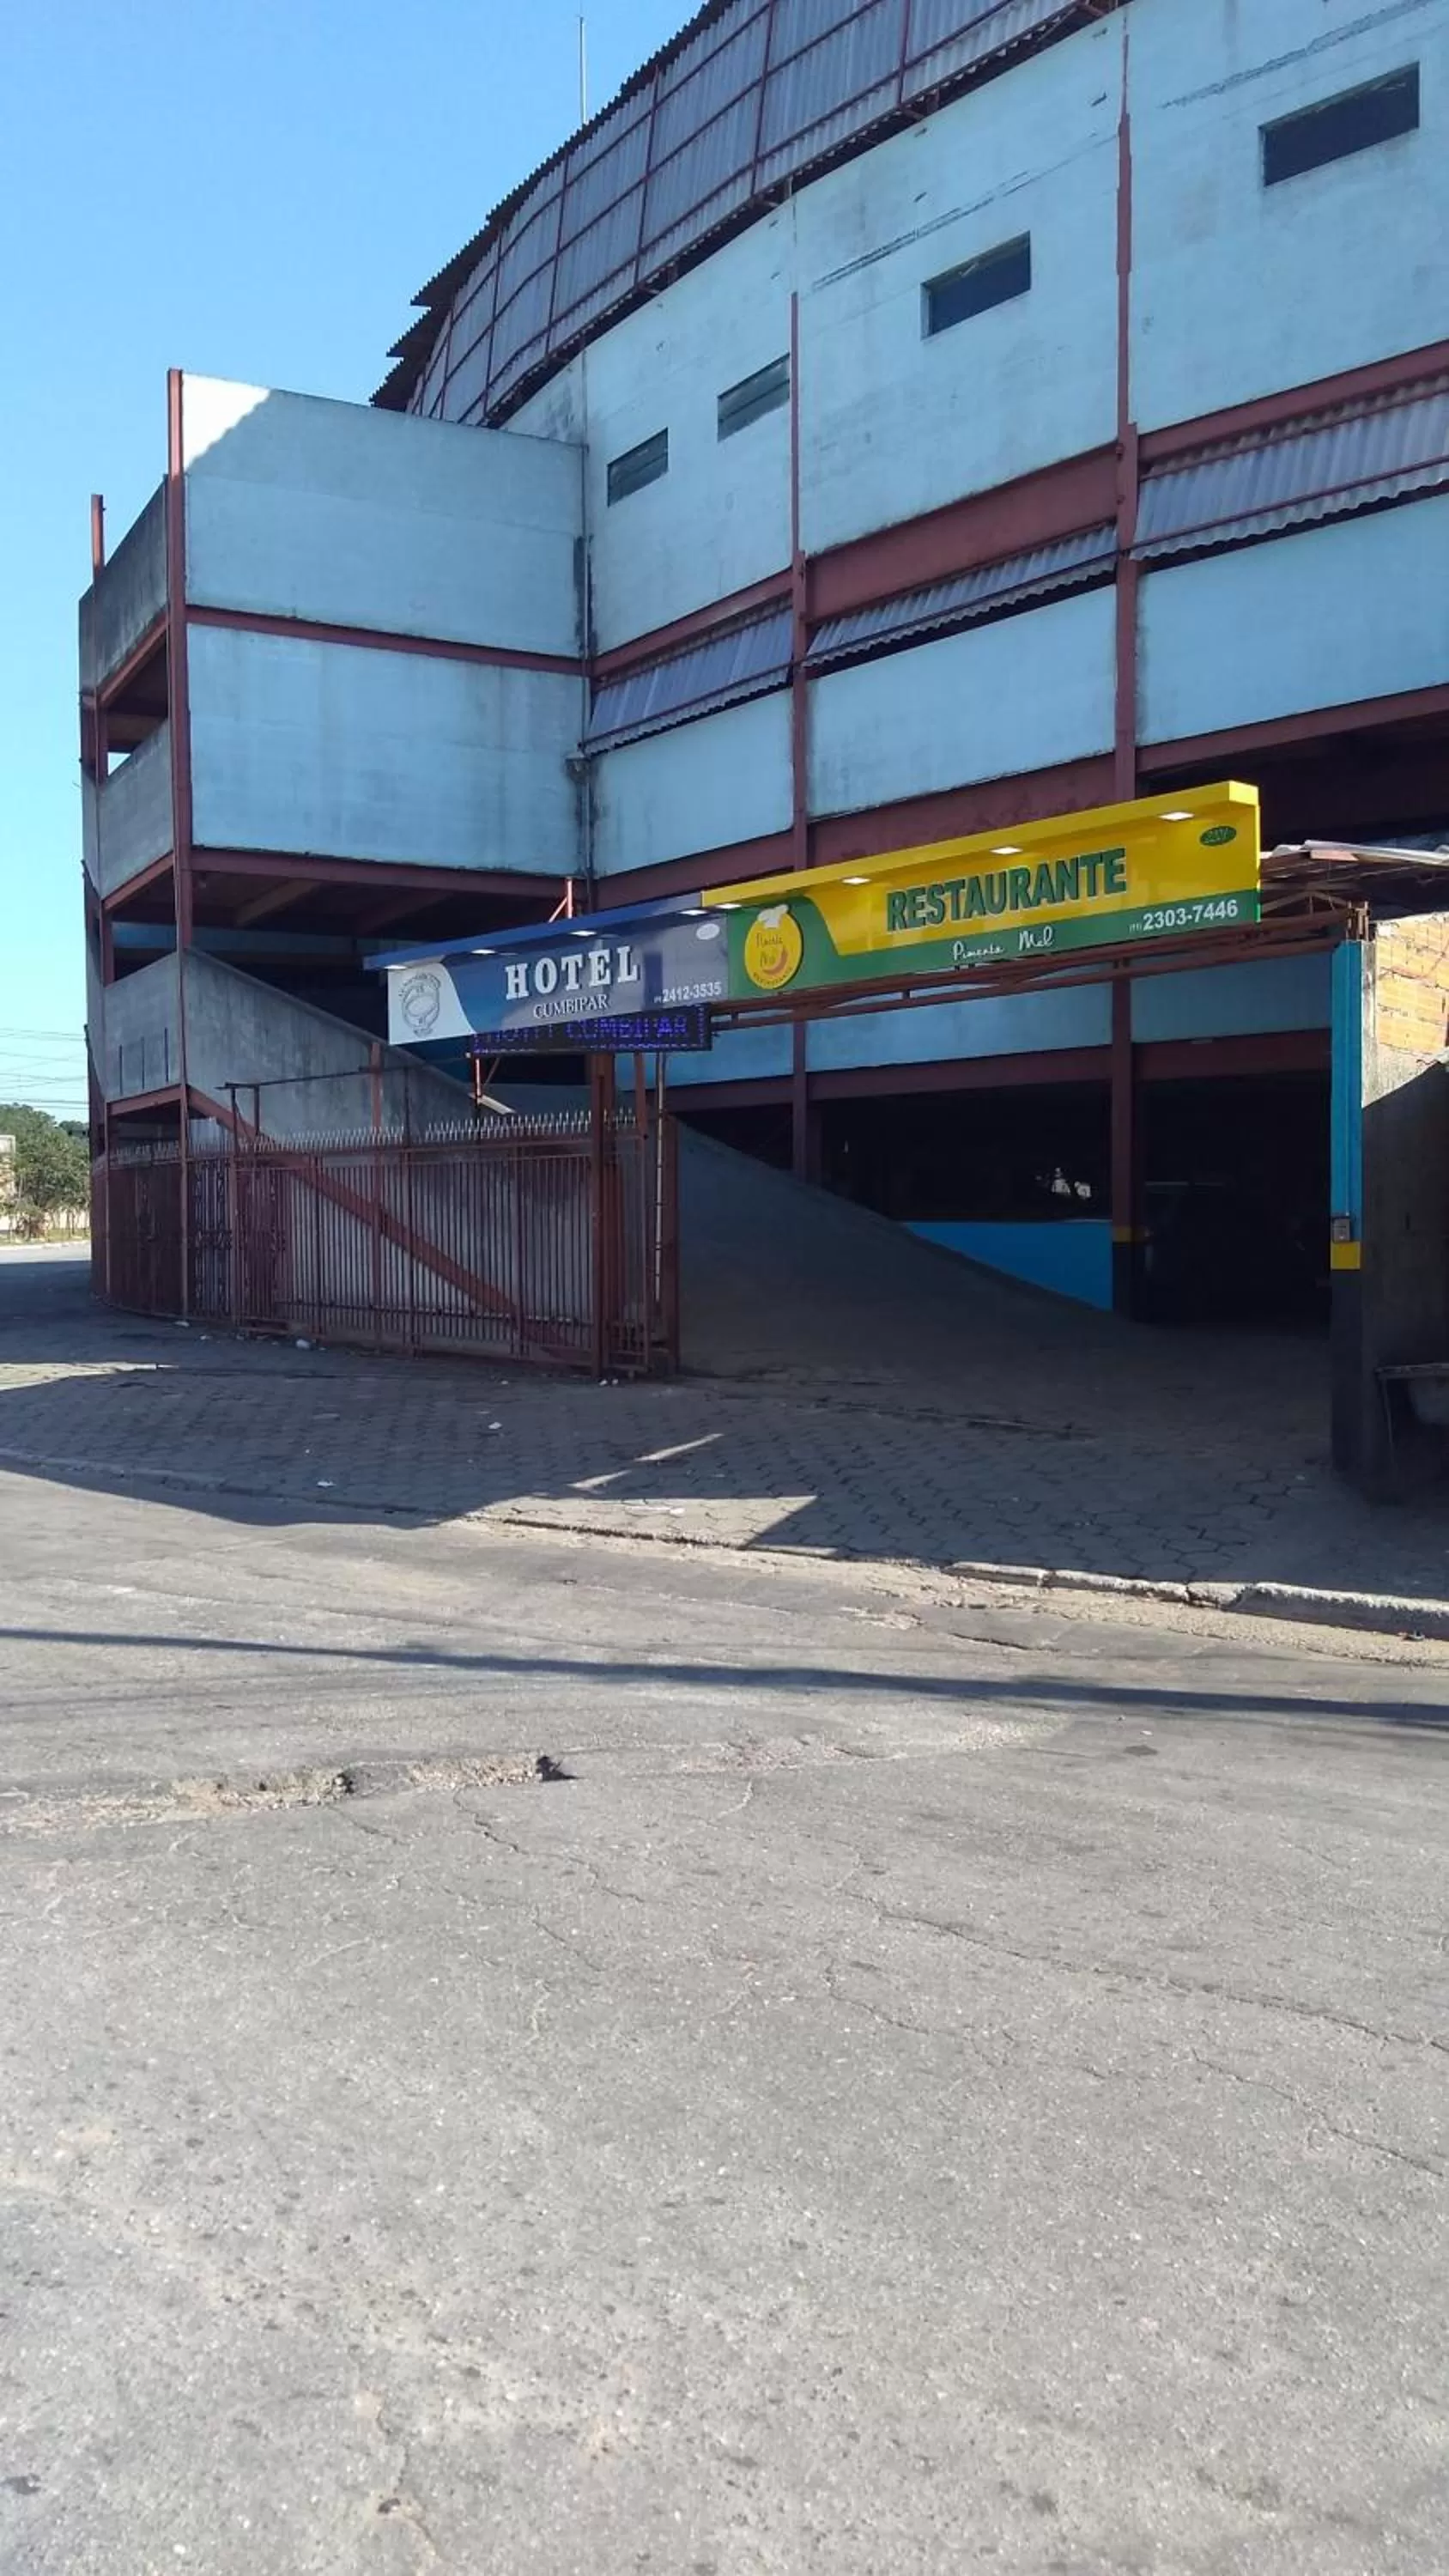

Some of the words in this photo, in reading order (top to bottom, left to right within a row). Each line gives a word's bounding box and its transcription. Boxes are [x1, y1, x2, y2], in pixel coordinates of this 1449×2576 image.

[887, 848, 1127, 932] RESTAURANTE
[1143, 899, 1239, 932] 2303-7446
[505, 946, 638, 1000] HOTEL
[533, 993, 609, 1019] CUMBIPAR
